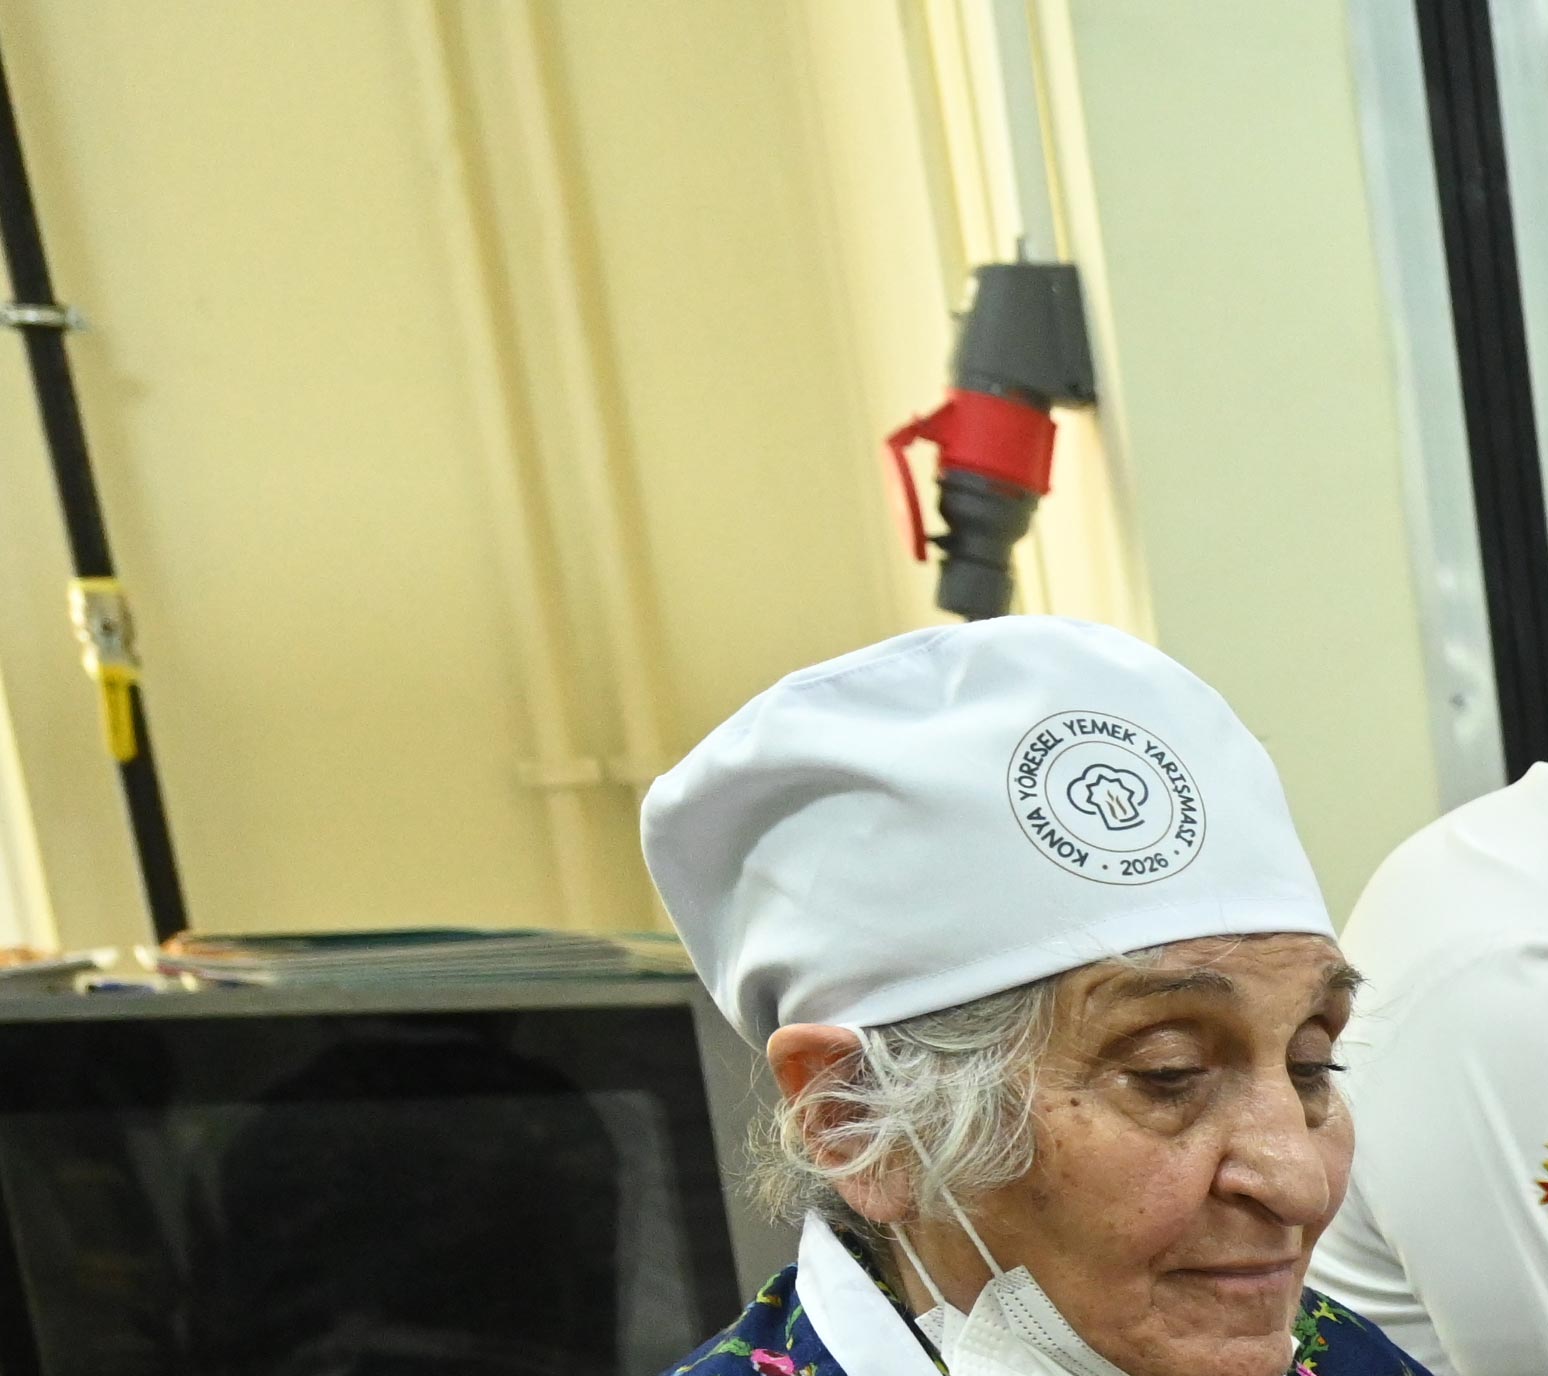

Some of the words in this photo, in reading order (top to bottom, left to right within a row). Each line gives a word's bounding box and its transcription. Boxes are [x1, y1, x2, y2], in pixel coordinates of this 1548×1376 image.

[1063, 718, 1137, 746] YEMEK
[1014, 729, 1064, 801] YÖRESEL
[1143, 740, 1198, 848] YARIŞMASI
[1027, 806, 1089, 868] KONYA
[1120, 852, 1169, 876] 2026
